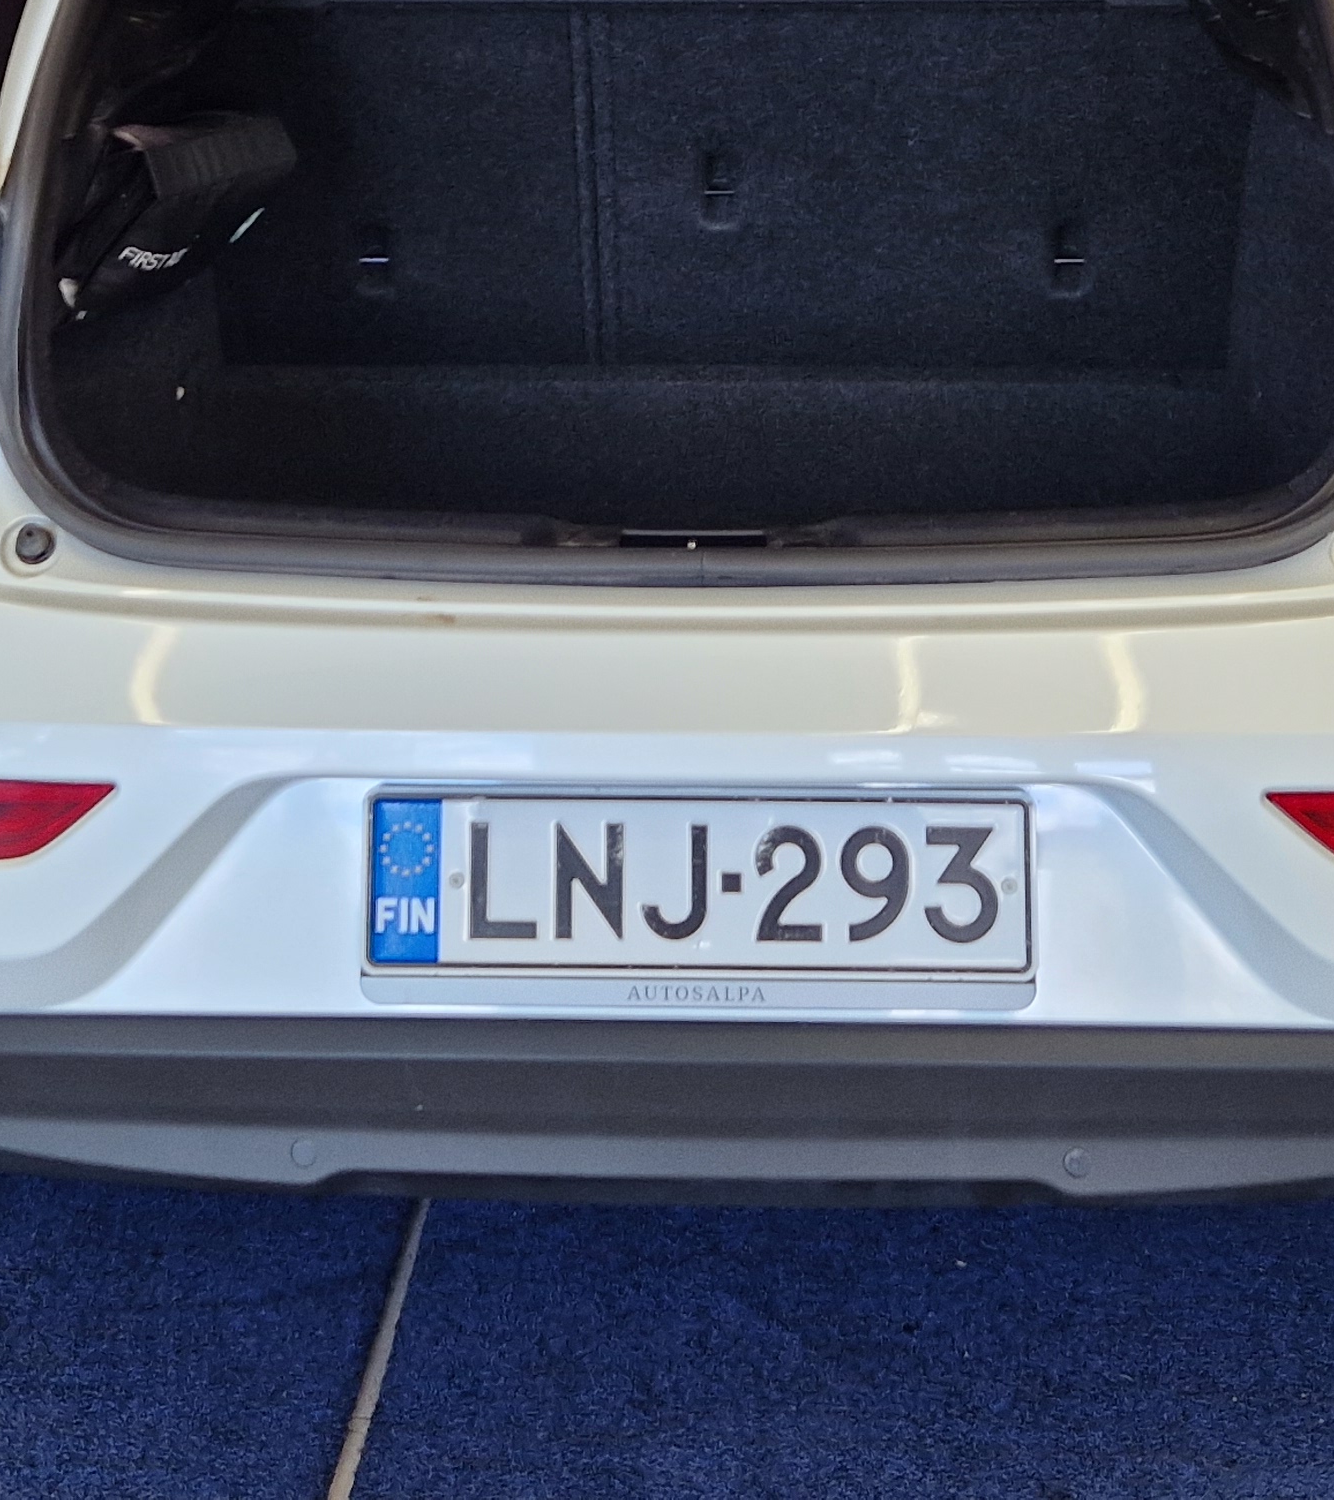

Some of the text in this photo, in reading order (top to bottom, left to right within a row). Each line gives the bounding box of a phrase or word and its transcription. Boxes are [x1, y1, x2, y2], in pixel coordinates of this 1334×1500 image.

[117, 246, 172, 271] FIRST
[374, 821, 999, 944] FIN LNJ-293
[627, 985, 766, 1001] AUTOSALPA
